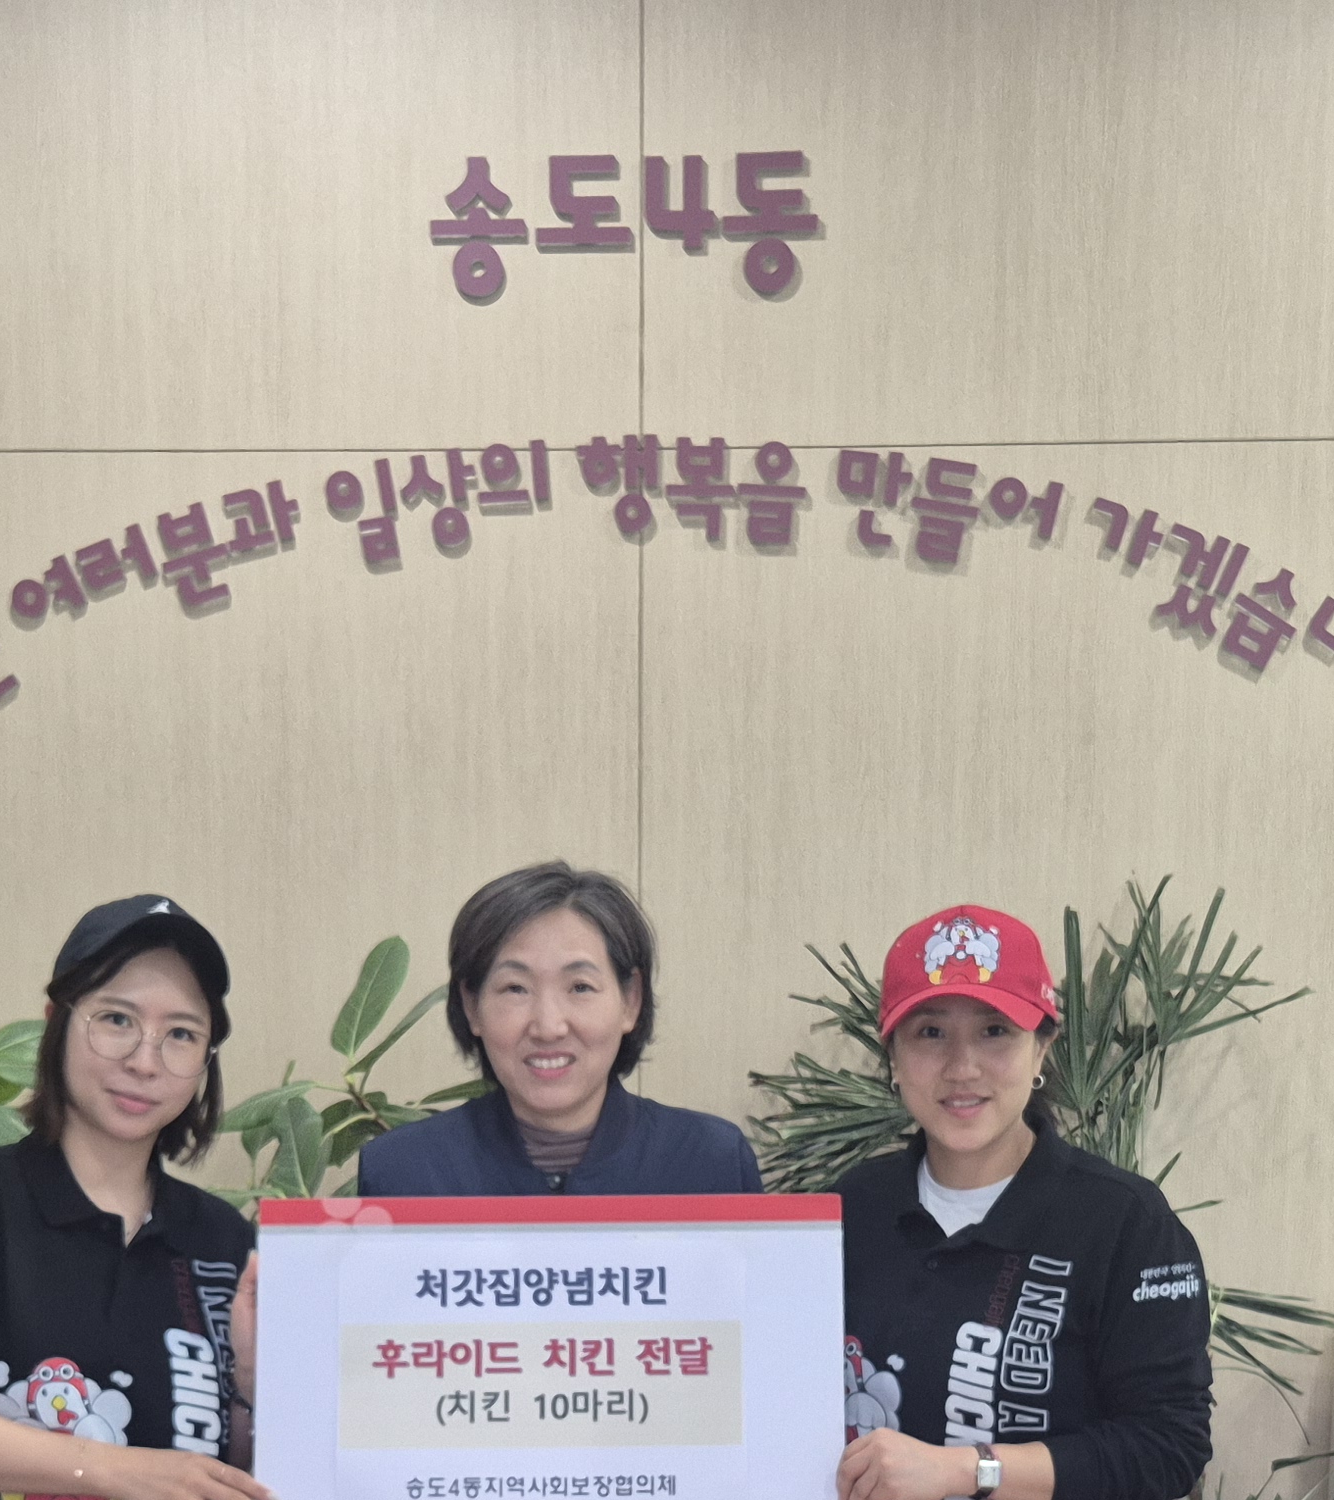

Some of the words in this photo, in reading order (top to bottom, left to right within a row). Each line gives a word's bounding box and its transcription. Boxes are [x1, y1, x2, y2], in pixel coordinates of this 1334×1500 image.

[430, 150, 823, 304] 송도4동
[10, 479, 300, 616] 여러분과
[325, 440, 552, 572] 일상의
[576, 433, 807, 548] 행복을
[833, 449, 1065, 564] 만들어
[415, 1265, 668, 1308] 처갓집양념치킨
[372, 1338, 524, 1378] 후라이드
[543, 1337, 616, 1376] 치킨
[636, 1337, 714, 1376] 전달
[1000, 1280, 1067, 1394] NEED
[435, 1390, 511, 1425] (치킨
[533, 1389, 650, 1424] 10마리)
[998, 1399, 1050, 1434] A
[406, 1473, 678, 1498] 송도4동지역사회보장협의체
